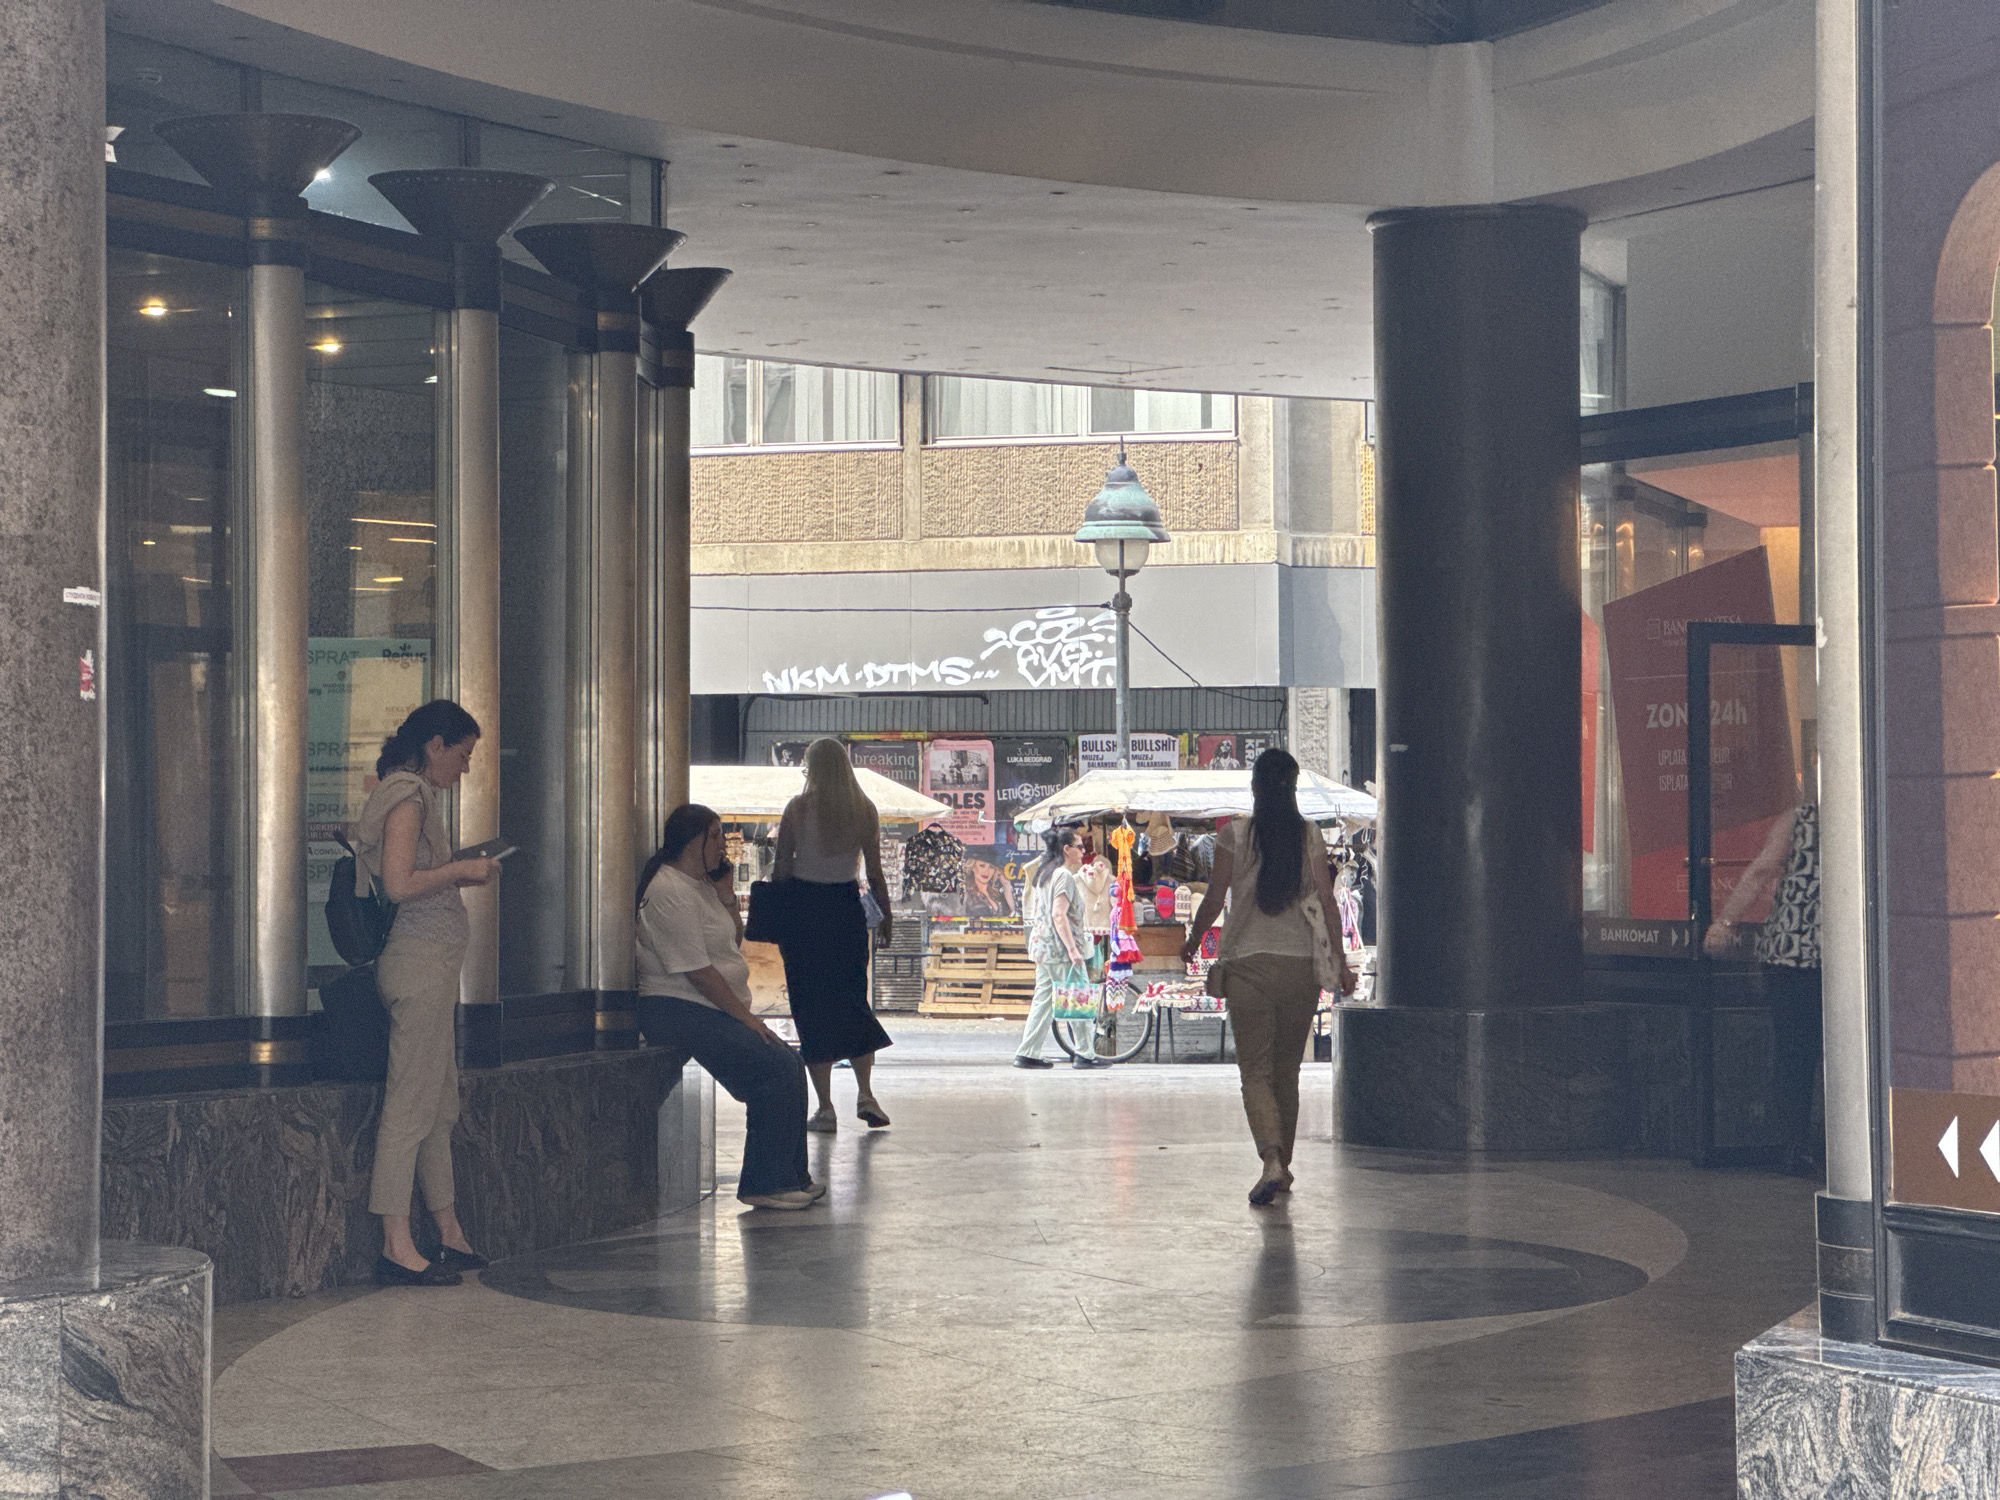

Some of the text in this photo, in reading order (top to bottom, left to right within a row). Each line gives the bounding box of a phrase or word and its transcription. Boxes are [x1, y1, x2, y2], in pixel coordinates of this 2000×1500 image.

[382, 648, 427, 669] Regus
[762, 661, 850, 694] NKM
[1646, 698, 1748, 729] ZON 24h
[1025, 747, 1041, 756] JUL
[1081, 740, 1118, 752] BULLSH
[854, 753, 915, 767] breaking
[1024, 755, 1053, 763] BEOGRAD
[1658, 749, 1687, 767] UPLATA
[884, 770, 917, 780] amin
[1659, 774, 1689, 792] ISPLATA
[997, 787, 1018, 801] LETU
[310, 823, 342, 831] URKISH
[1600, 927, 1660, 943] BANKOMAT
